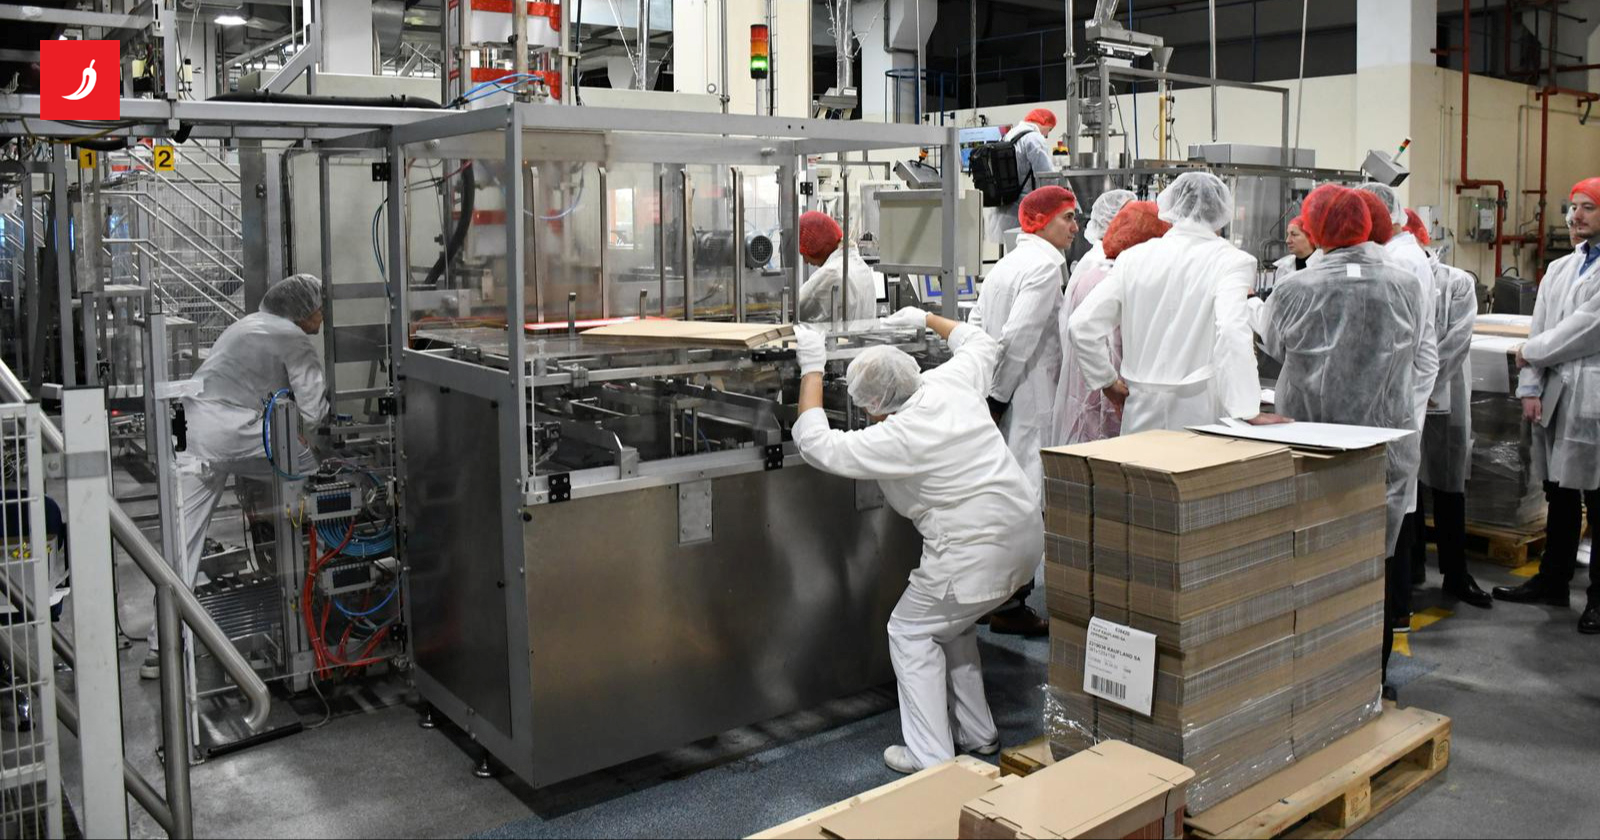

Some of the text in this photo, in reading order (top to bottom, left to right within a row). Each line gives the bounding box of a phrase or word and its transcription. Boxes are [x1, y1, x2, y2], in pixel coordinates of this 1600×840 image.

[85, 152, 92, 166] 1
[158, 150, 172, 168] 2
[1107, 646, 1133, 660] KAUFLAND
